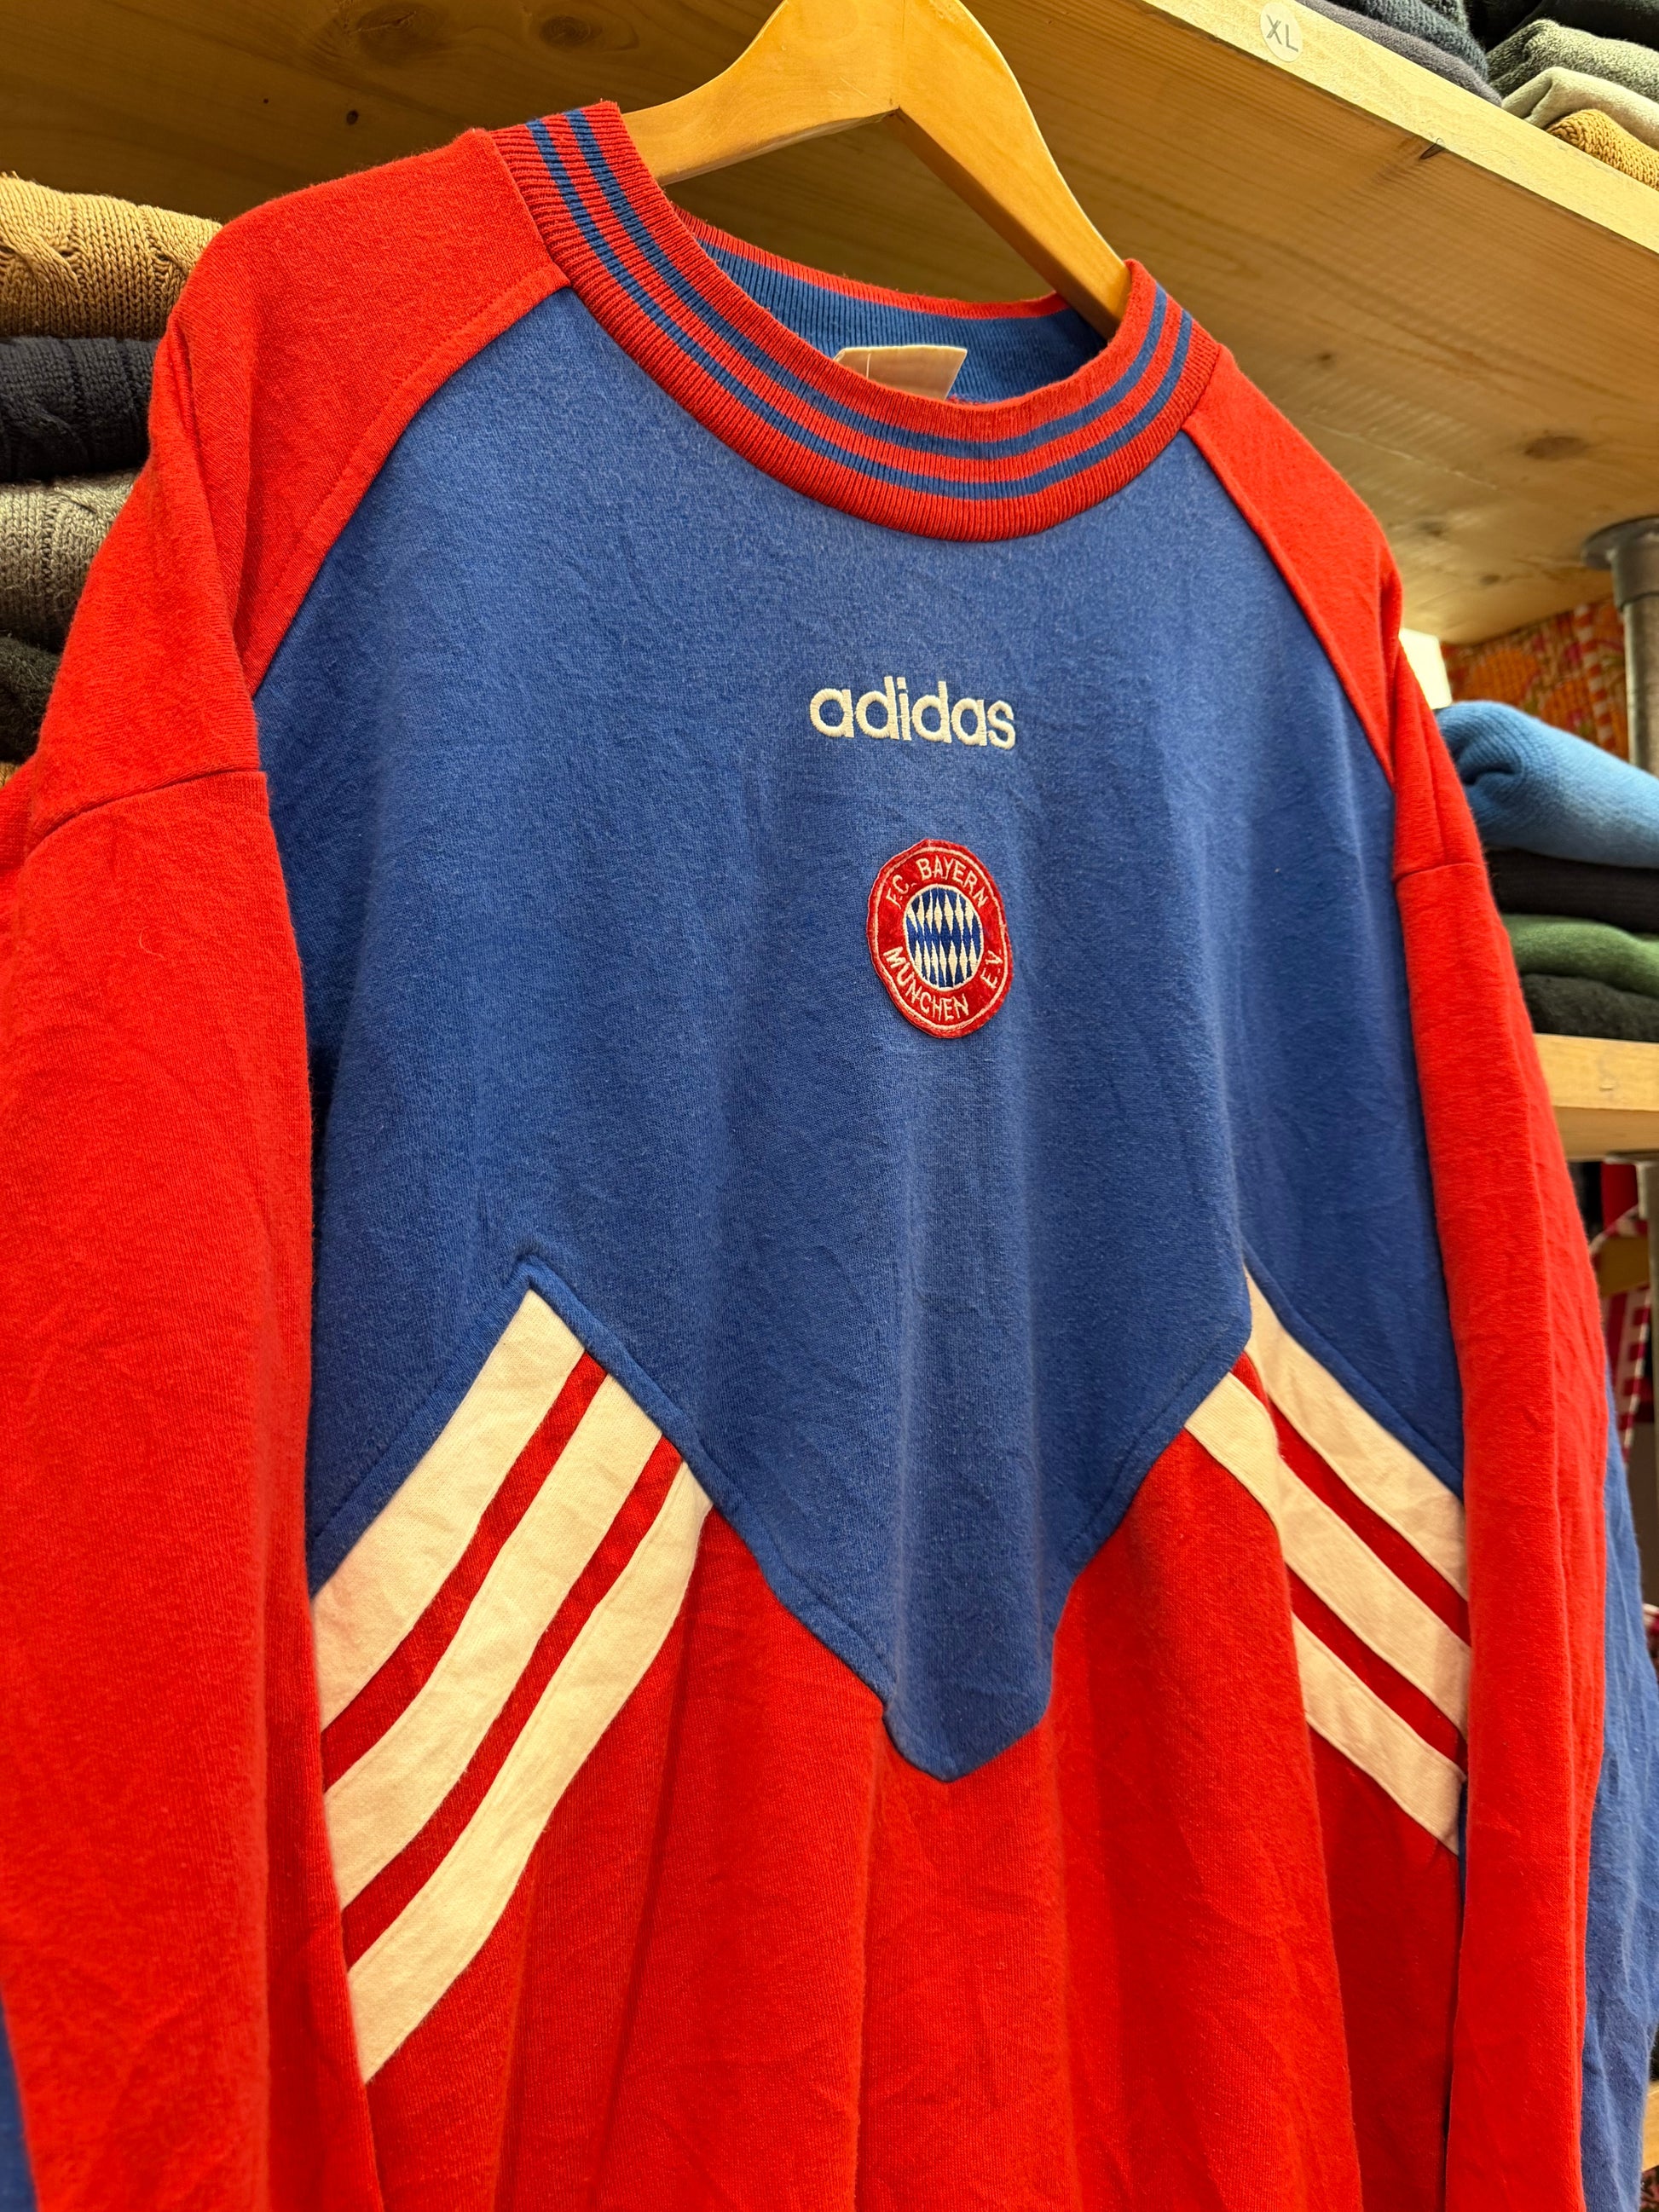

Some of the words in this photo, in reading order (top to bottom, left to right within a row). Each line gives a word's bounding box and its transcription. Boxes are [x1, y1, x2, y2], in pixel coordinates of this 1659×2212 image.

[1266, 14, 1298, 52] XL
[810, 675, 1015, 750] adidas
[916, 855, 988, 908] BAYERN
